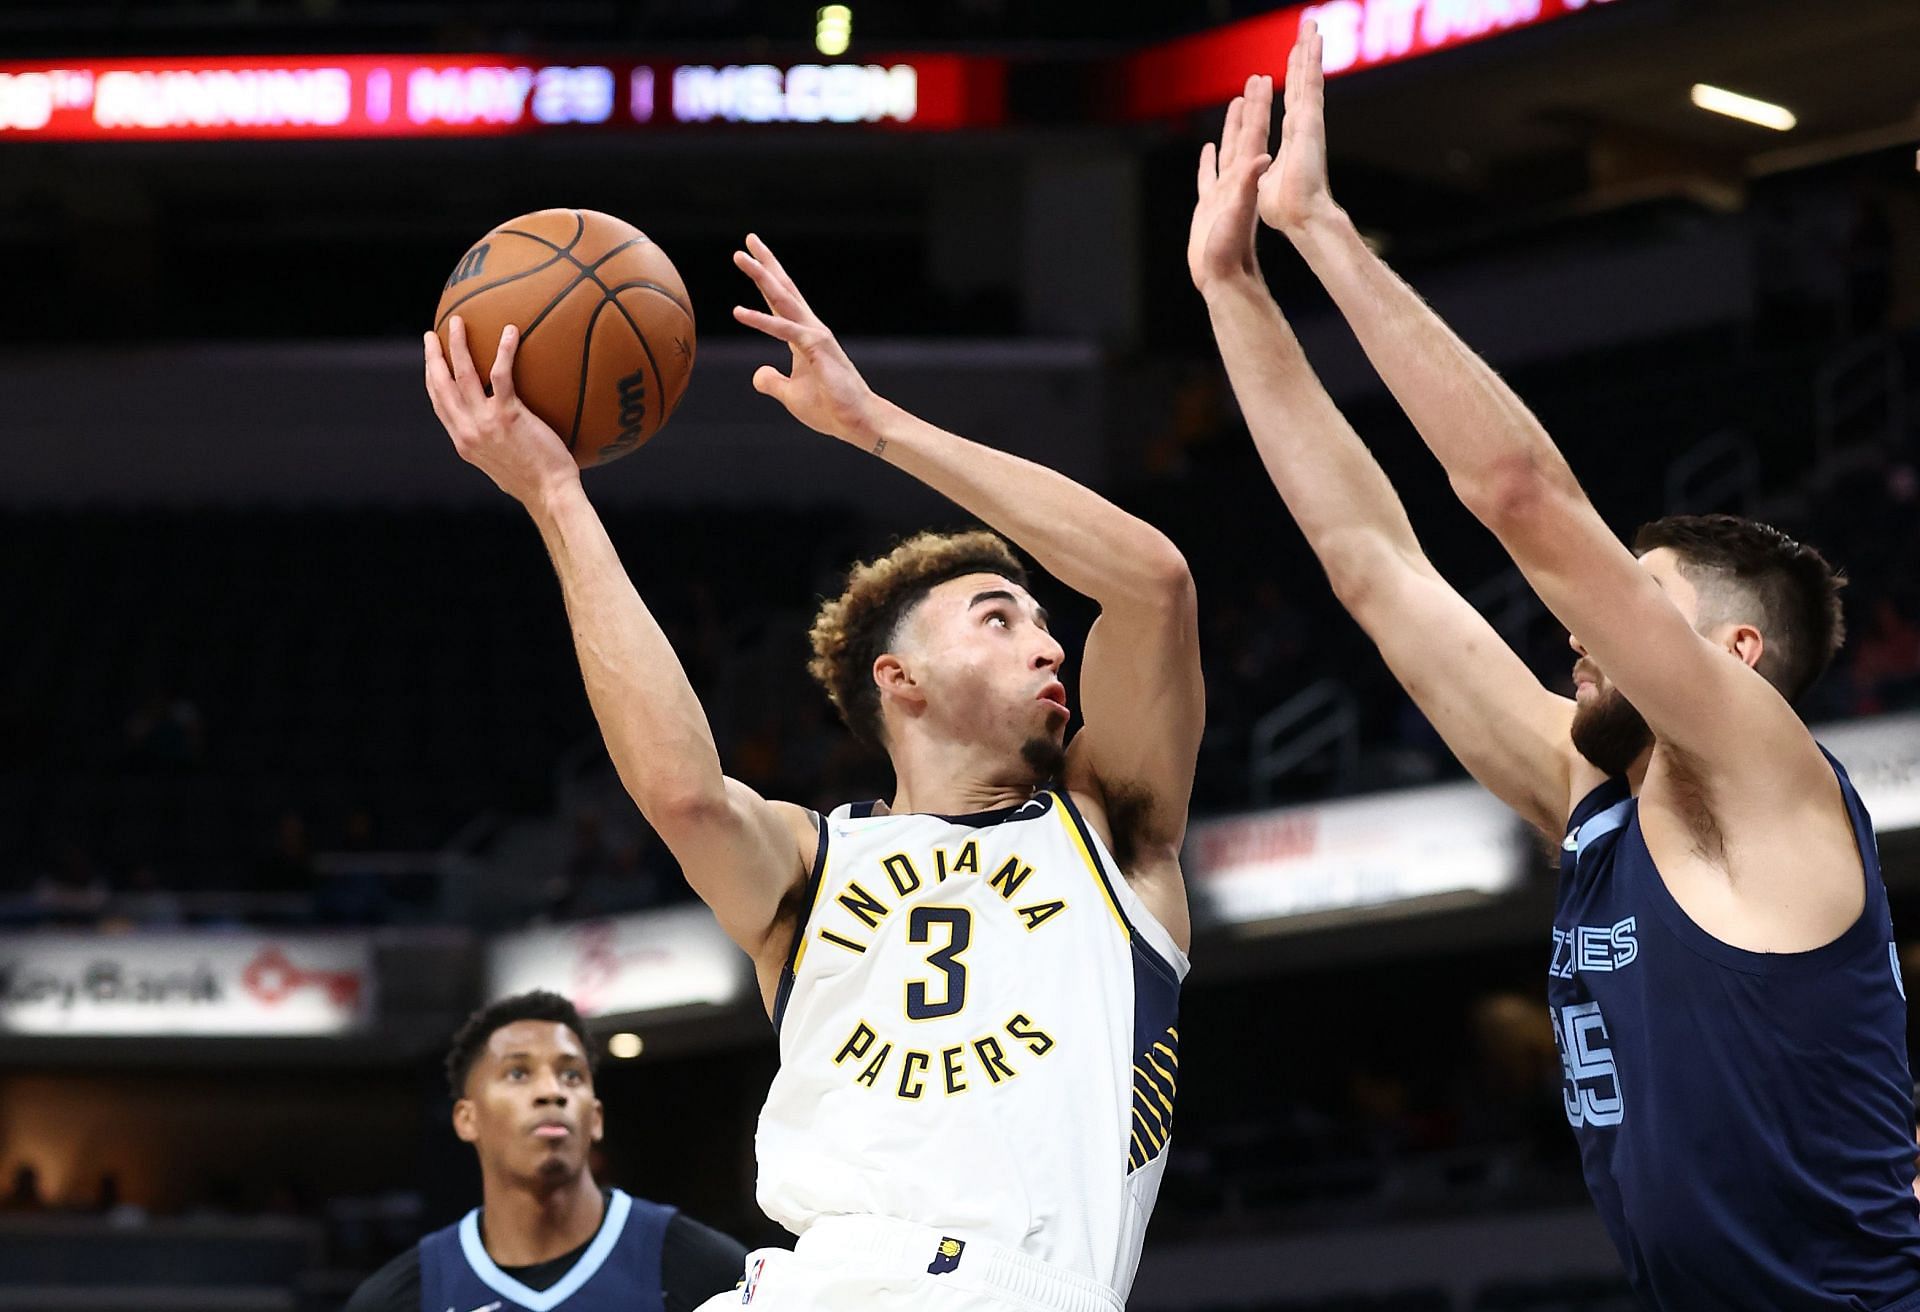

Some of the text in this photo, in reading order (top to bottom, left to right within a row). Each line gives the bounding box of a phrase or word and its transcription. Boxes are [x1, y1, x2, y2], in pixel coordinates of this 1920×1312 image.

[95, 67, 350, 128] RUNNING
[406, 66, 532, 125] MAY
[672, 64, 918, 124] IMS.COM
[817, 838, 1068, 956] INDIANA
[905, 903, 974, 1022] 3
[831, 1012, 1056, 1101] PACERS
